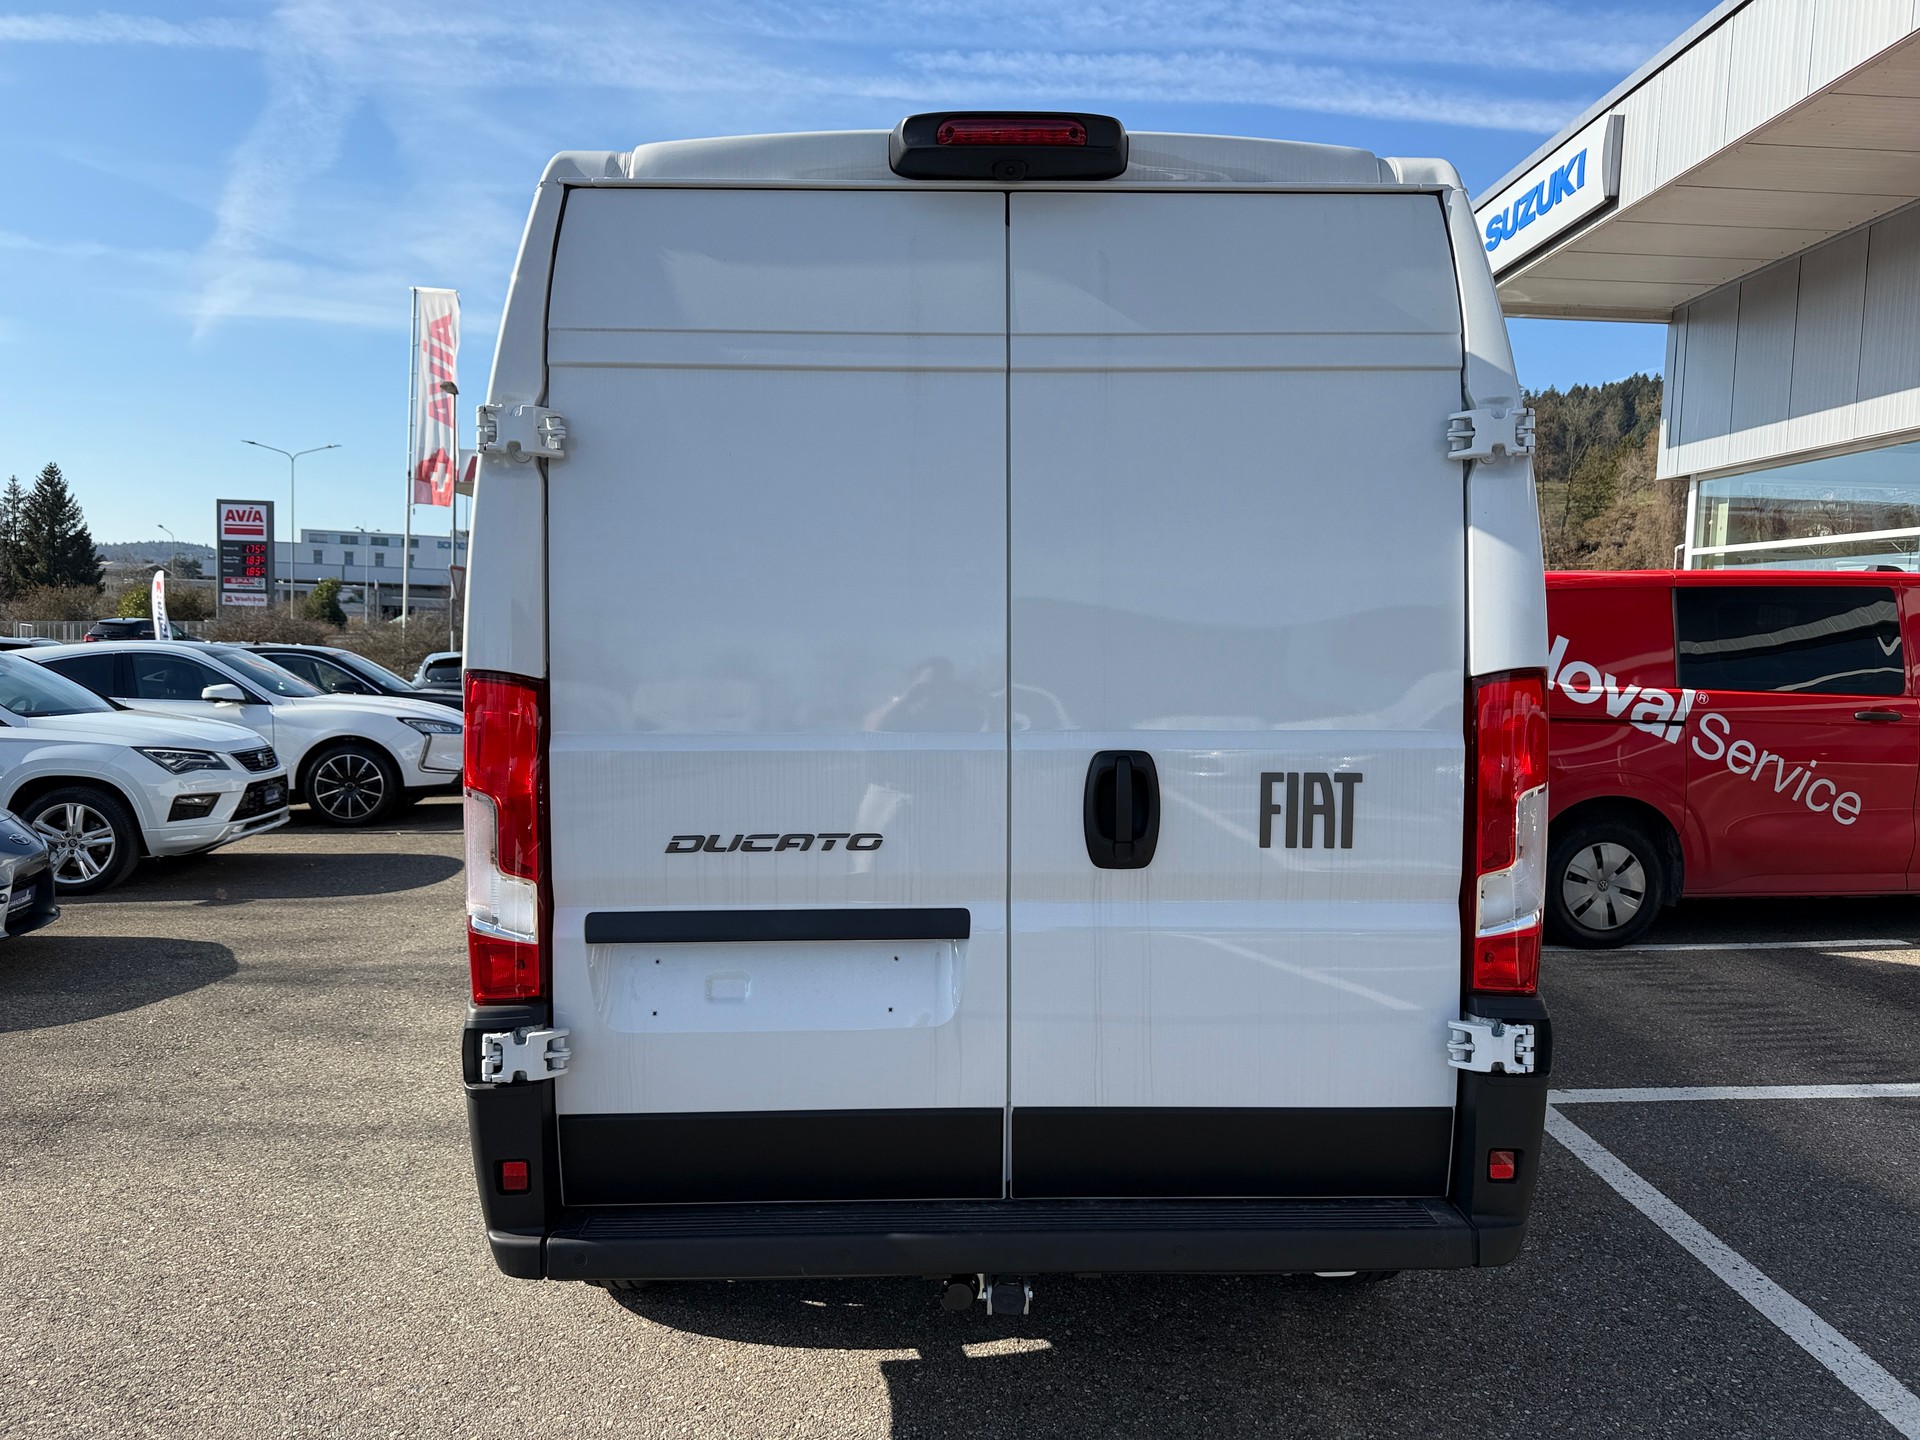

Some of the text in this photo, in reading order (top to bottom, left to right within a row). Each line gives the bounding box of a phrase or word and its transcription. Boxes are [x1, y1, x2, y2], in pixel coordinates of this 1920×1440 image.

[1485, 147, 1588, 252] SUZUKI
[422, 313, 455, 429] AVIA
[224, 507, 264, 522] AVIA
[1259, 772, 1363, 849] FIAT
[1691, 712, 1862, 826] Service
[665, 833, 883, 853] DUCATO
